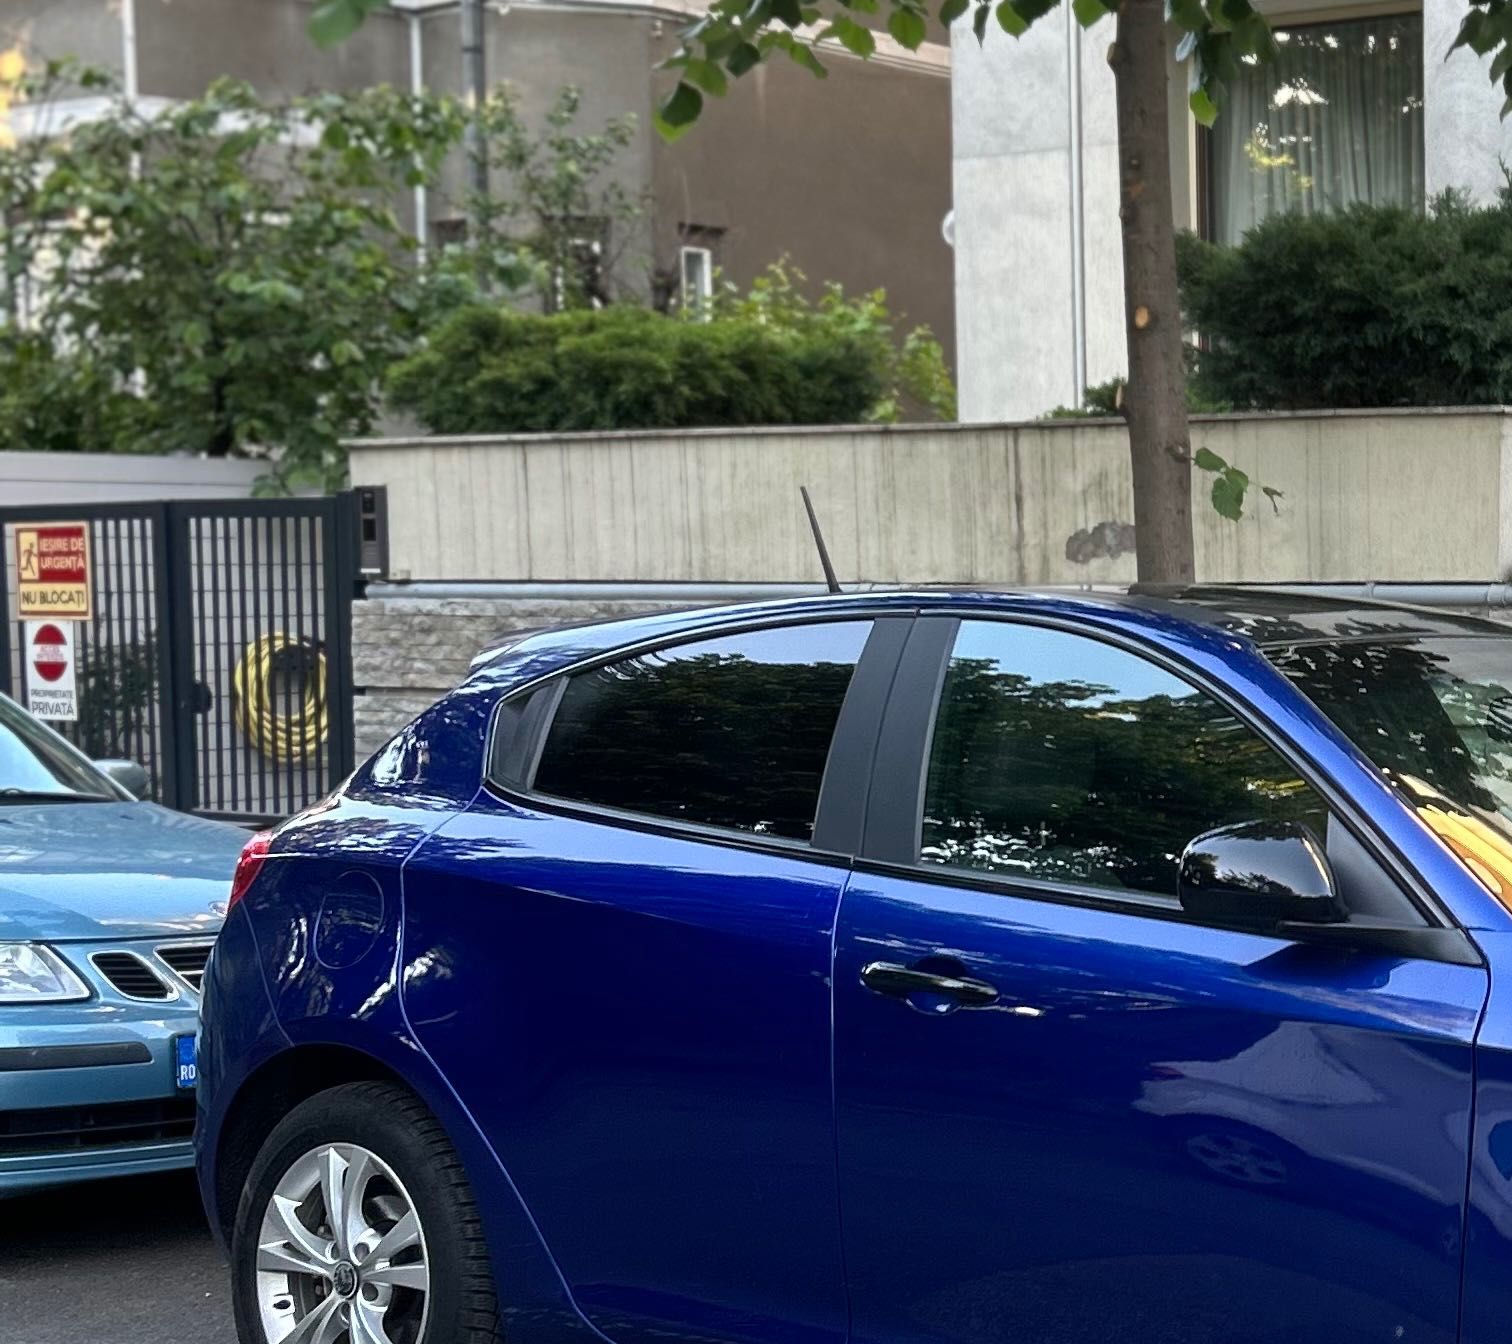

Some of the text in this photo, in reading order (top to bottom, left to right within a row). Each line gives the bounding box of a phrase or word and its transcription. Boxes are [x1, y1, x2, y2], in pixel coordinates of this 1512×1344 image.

[70, 537, 85, 551] DE
[22, 591, 37, 605] NU
[180, 1064, 196, 1081] RO
